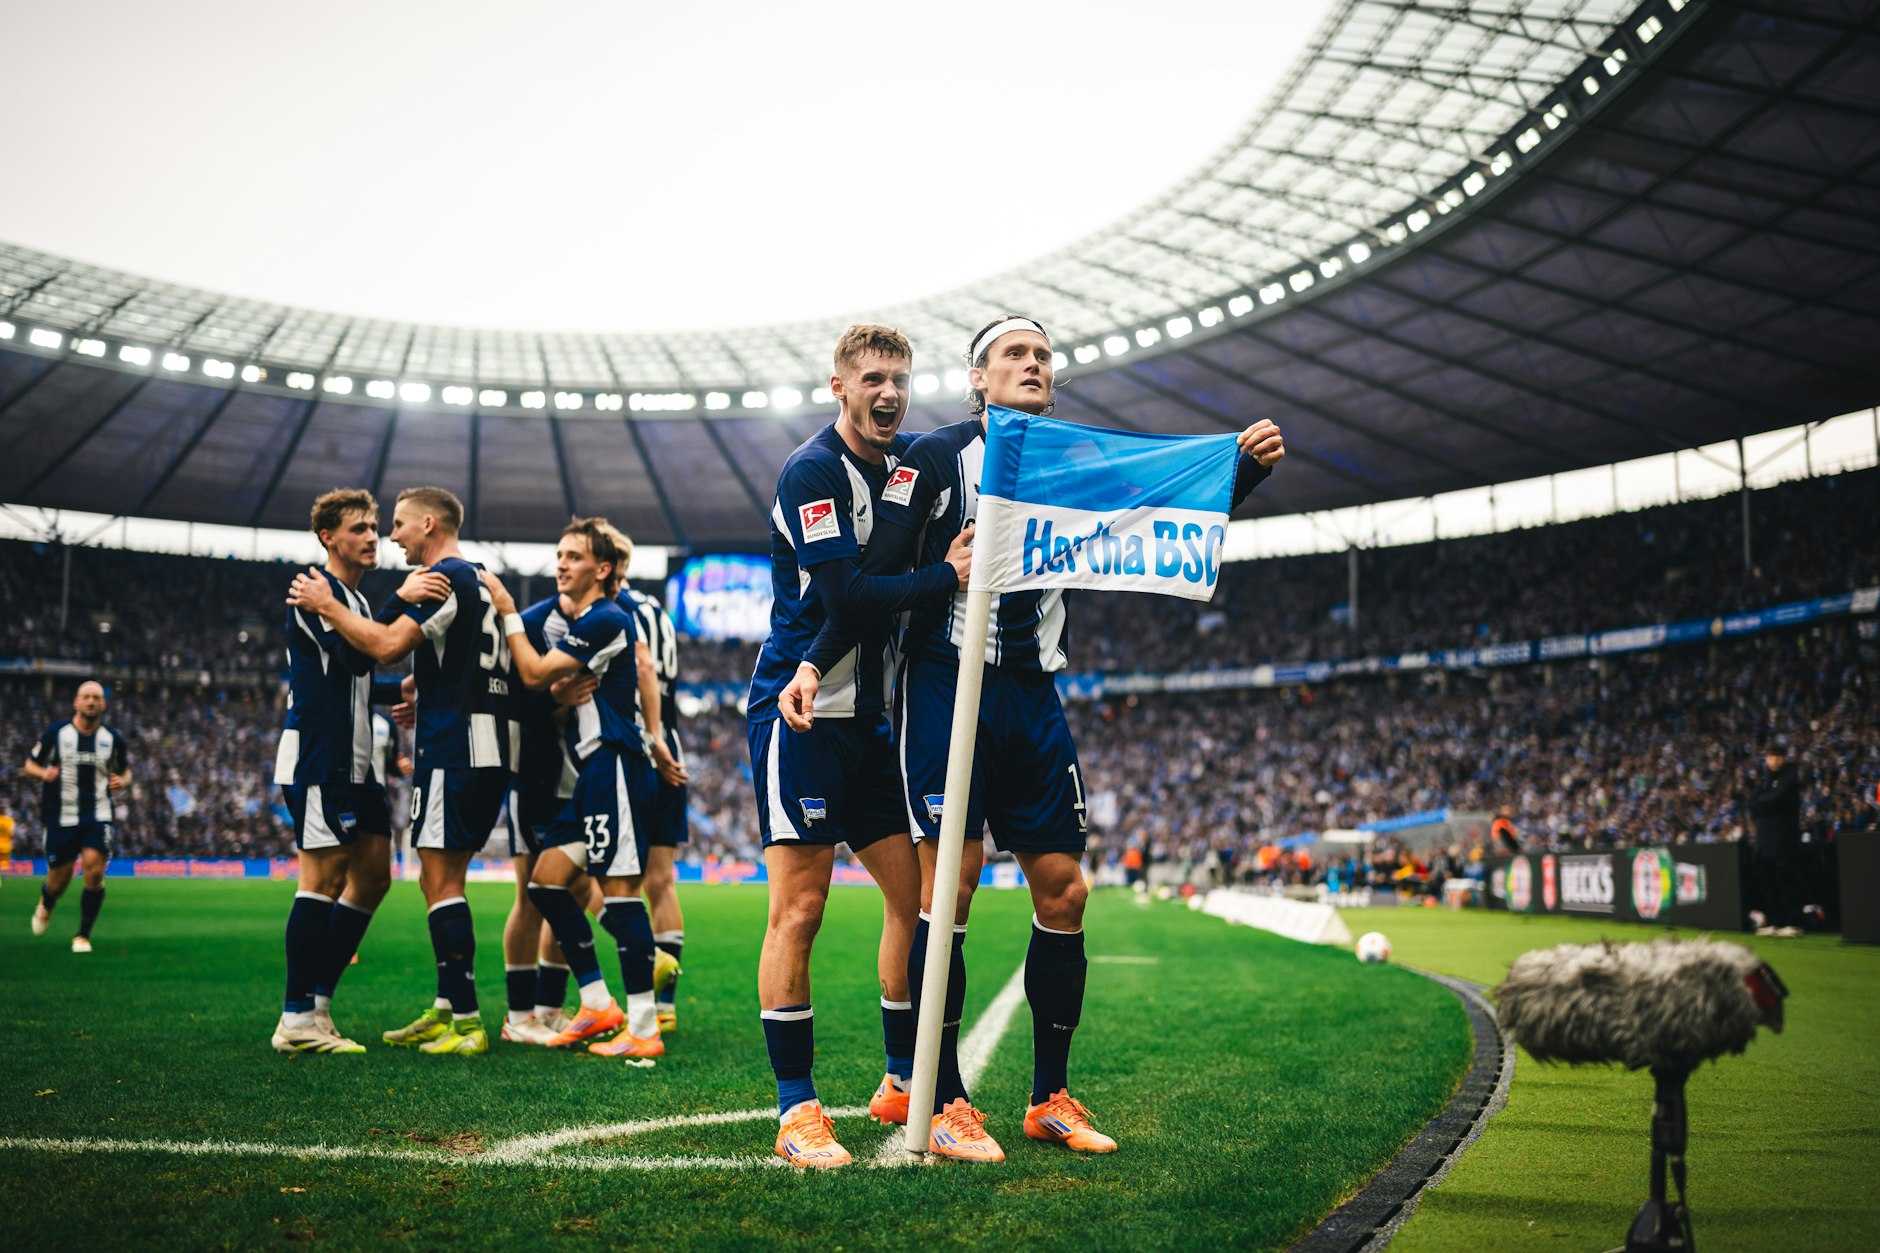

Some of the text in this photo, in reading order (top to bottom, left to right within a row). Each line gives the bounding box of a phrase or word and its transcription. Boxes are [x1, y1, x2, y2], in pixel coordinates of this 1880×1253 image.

[885, 493, 907, 502] BUNDESLIGA
[900, 482, 909, 494] 2
[824, 515, 834, 527] 2
[806, 530, 837, 539] BUNDESLIGA
[1023, 517, 1225, 587] Hertha BSC
[638, 603, 678, 679] 18
[1067, 763, 1085, 810] 1
[583, 813, 610, 850] 33
